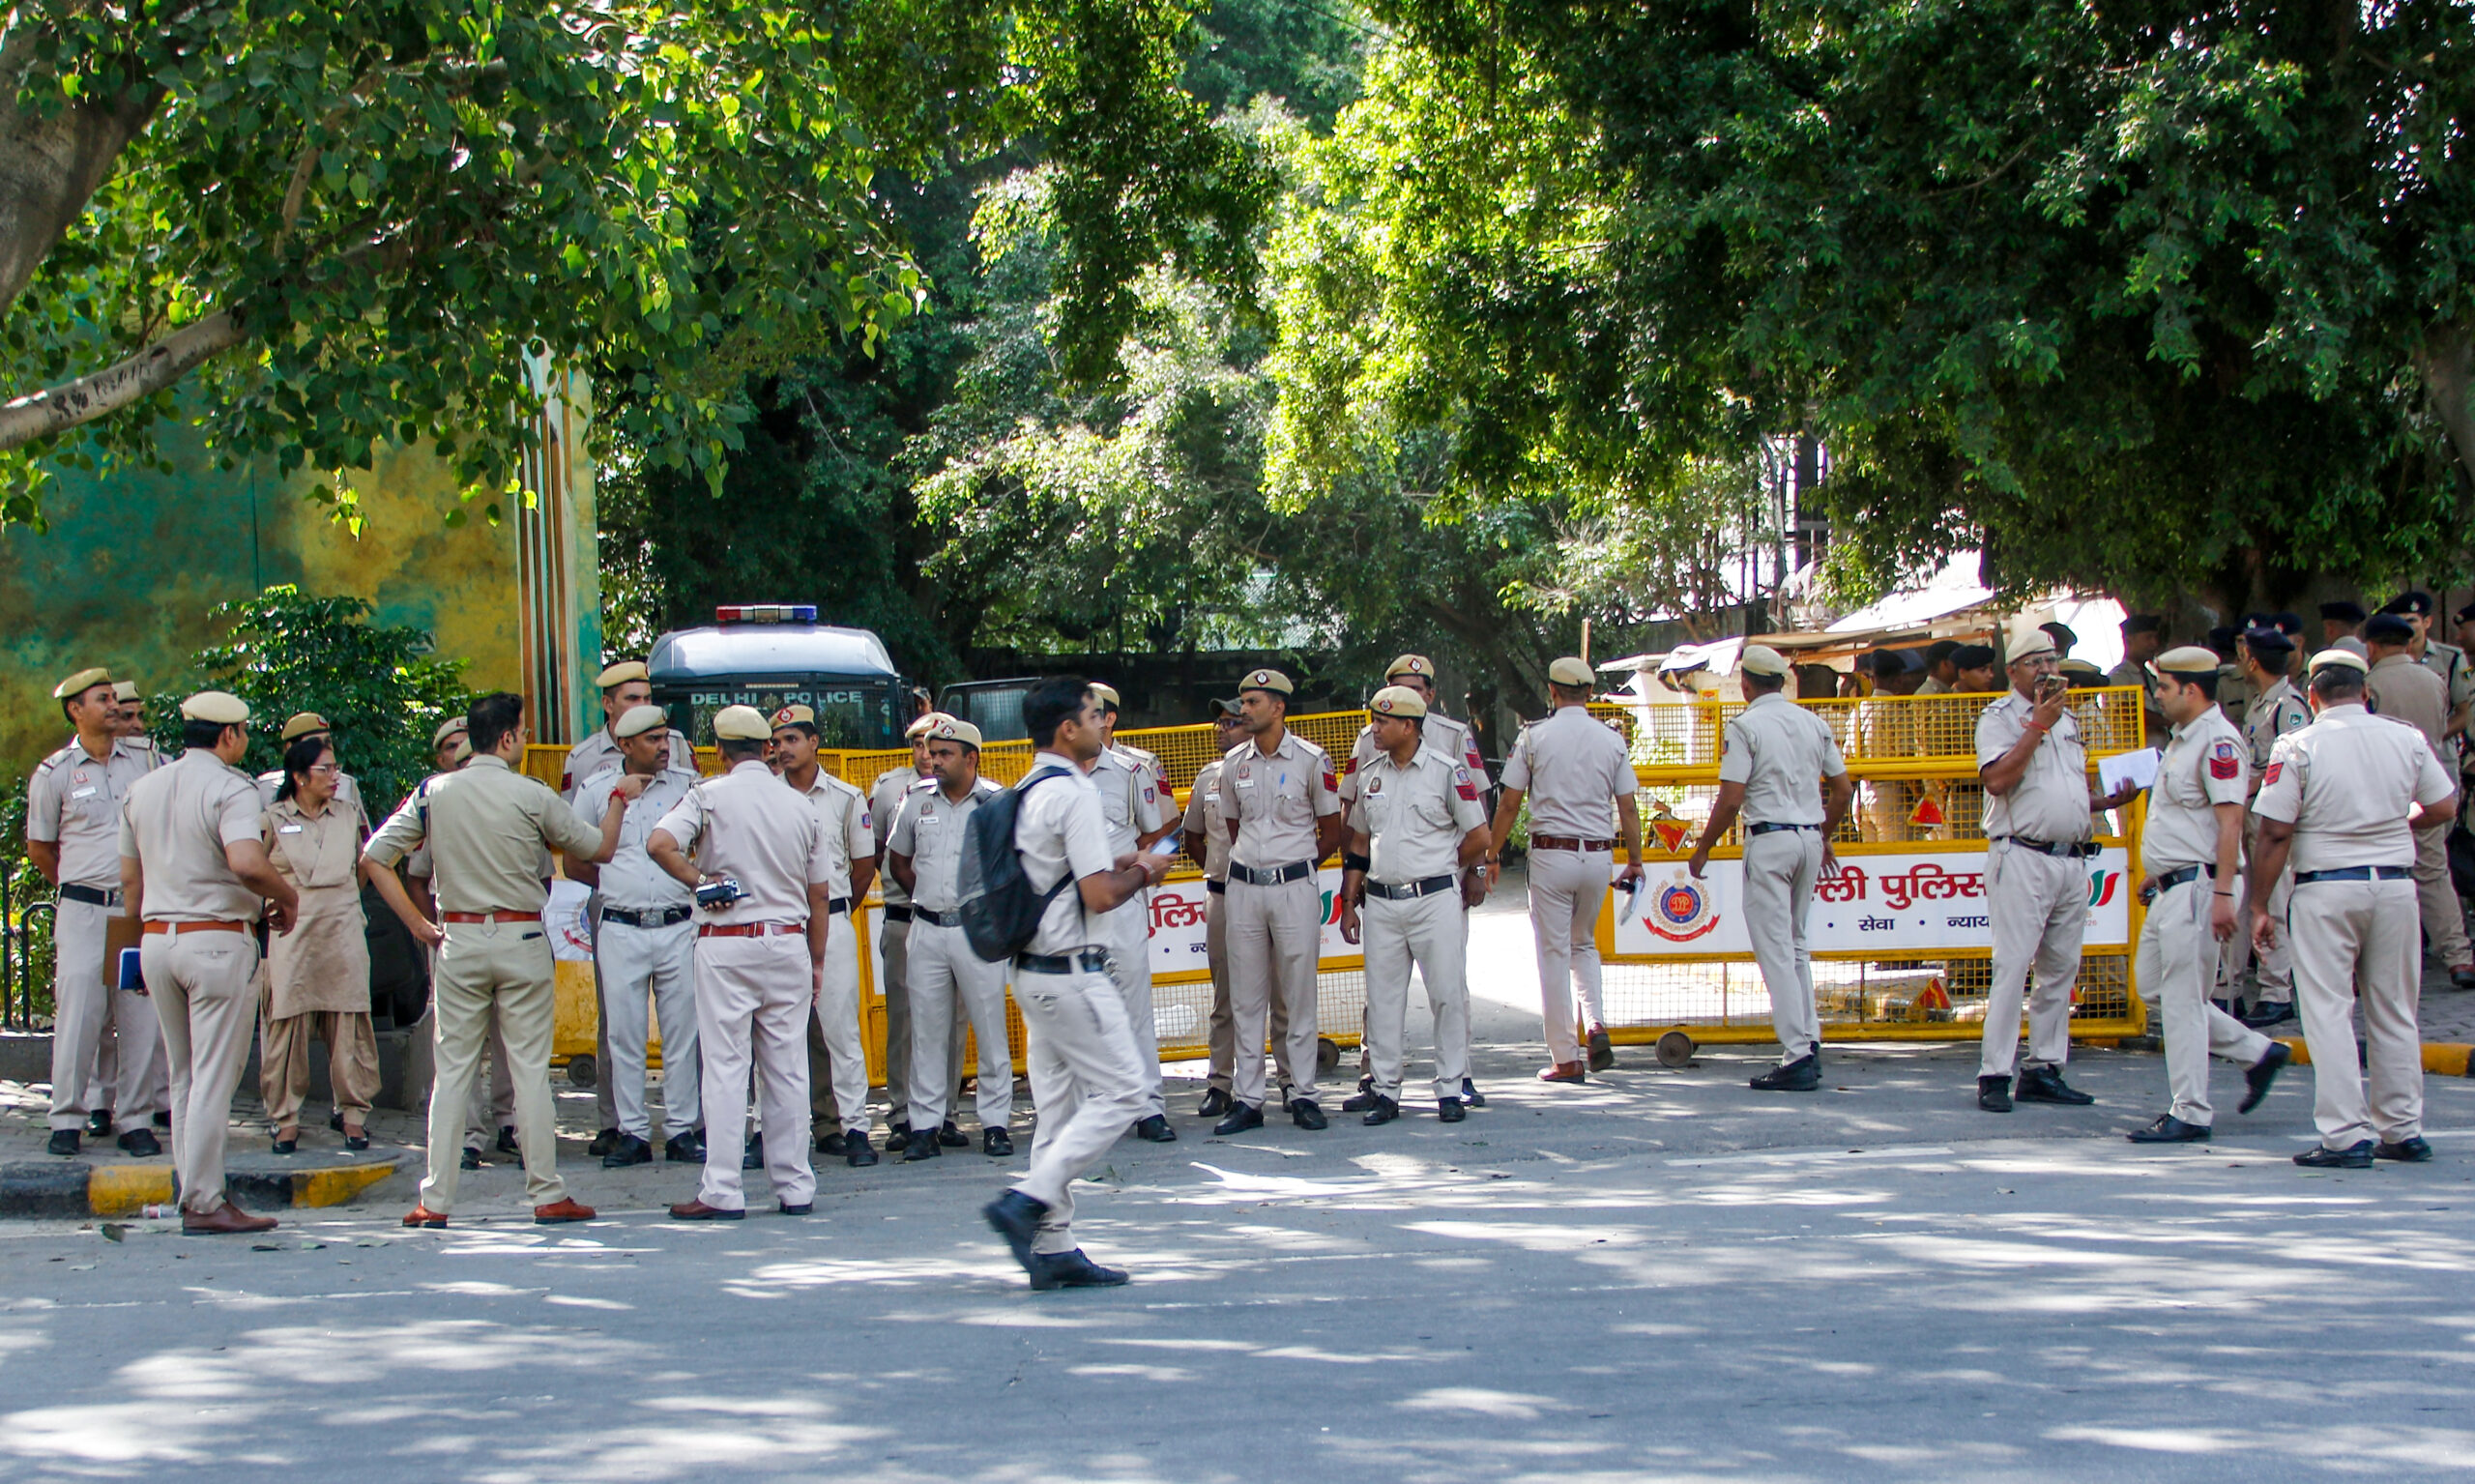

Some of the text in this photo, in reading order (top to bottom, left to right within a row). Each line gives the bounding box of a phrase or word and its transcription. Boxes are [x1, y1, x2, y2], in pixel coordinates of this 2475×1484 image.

[690, 690, 864, 705] DELHI POLICE
[1858, 915, 1990, 931] सेवा न्याय
